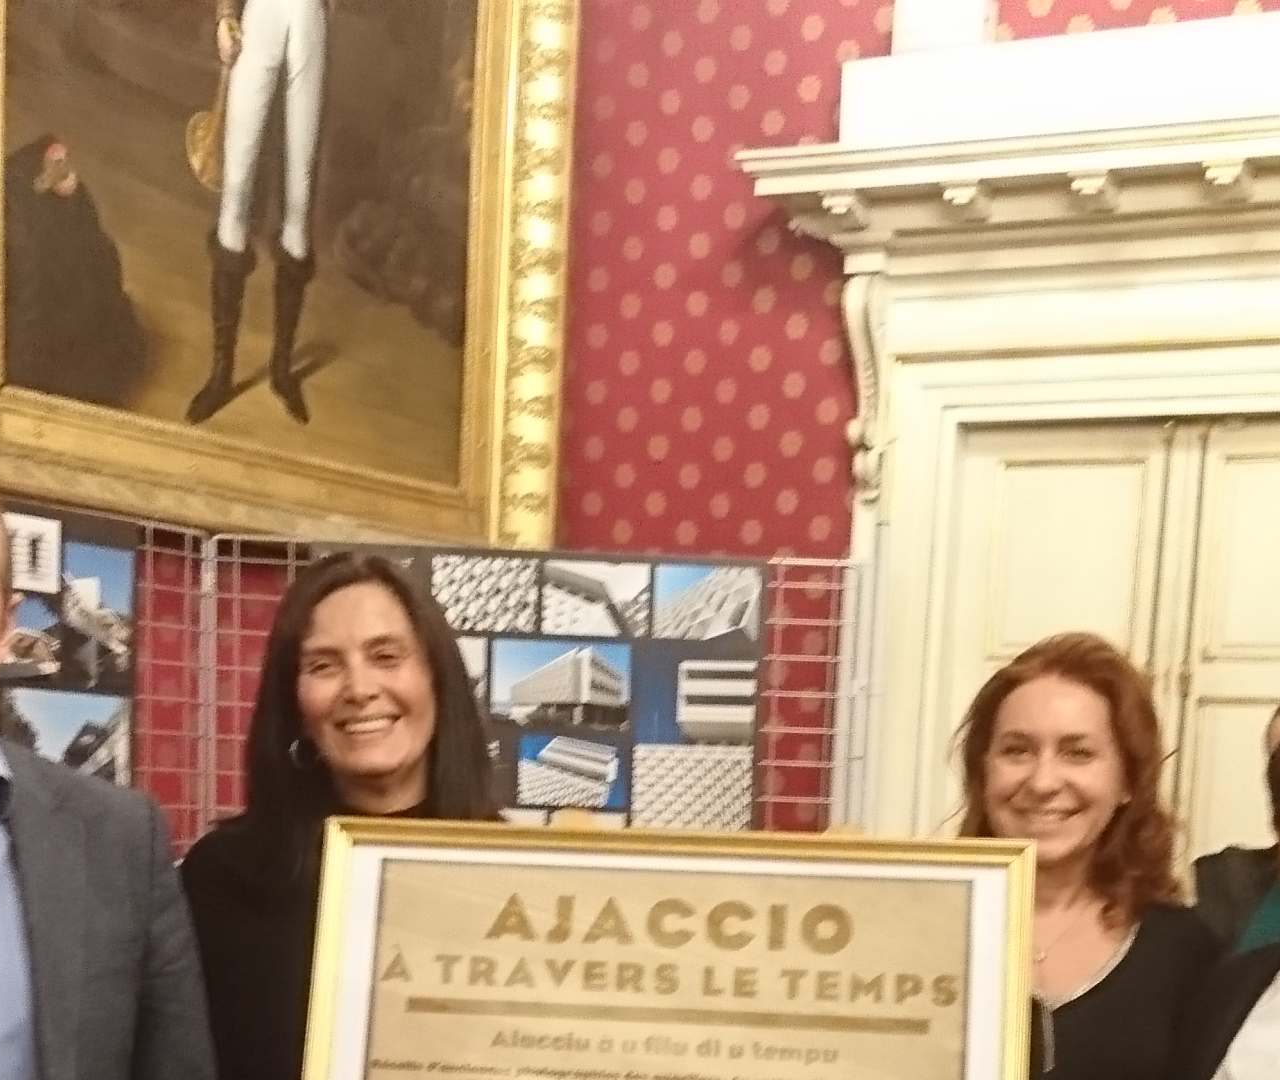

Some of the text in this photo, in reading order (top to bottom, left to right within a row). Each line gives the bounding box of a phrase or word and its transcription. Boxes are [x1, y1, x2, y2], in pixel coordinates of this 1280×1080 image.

[485, 892, 854, 955] AJACCIO
[380, 942, 961, 1008] À TRAVERS LE TEMPS
[696, 1039, 721, 1059] di
